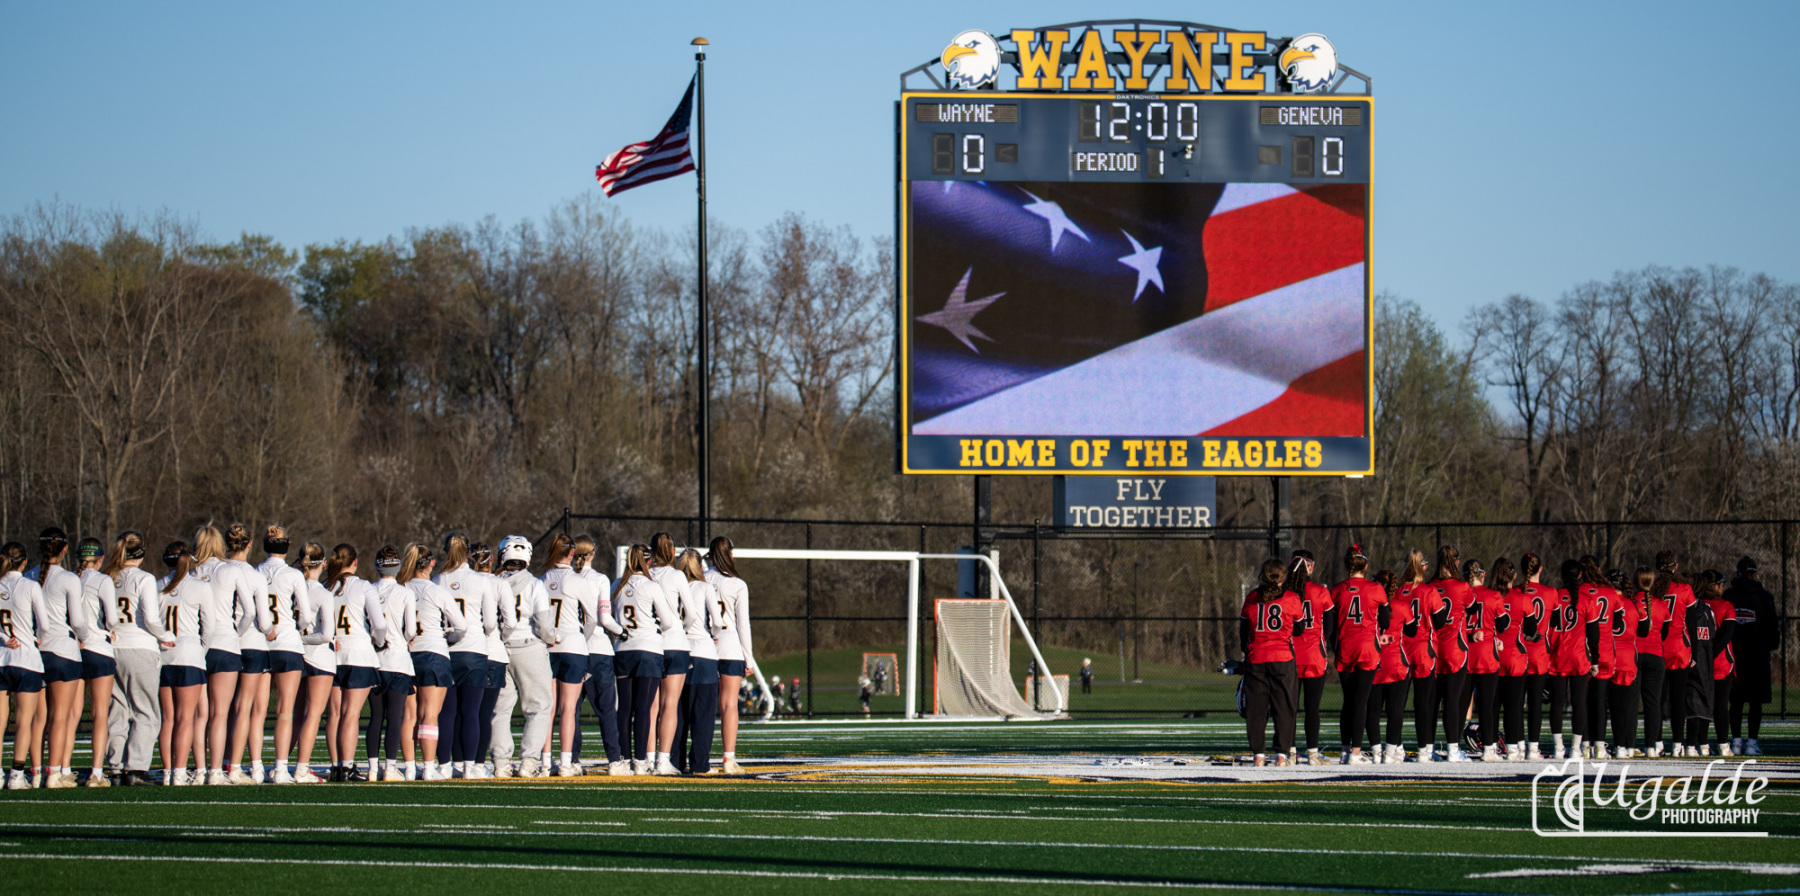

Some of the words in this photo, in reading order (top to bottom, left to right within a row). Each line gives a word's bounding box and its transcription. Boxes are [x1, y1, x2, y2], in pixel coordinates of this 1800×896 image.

[1010, 28, 1267, 92] WAYNE
[939, 103, 995, 122] WAYNE
[1095, 102, 1198, 140] 12:00
[1278, 106, 1343, 125] GENEVA
[963, 134, 984, 172] 0
[1077, 152, 1137, 171] PERIOD
[1322, 137, 1343, 175] 0
[959, 439, 1055, 468] HOME
[1070, 439, 1110, 468] OF
[1123, 439, 1188, 468] THE
[1202, 439, 1323, 468] EAGLES
[1116, 479, 1166, 501] FLY
[1069, 506, 1211, 528] TOGETHER
[118, 597, 133, 623] 3
[333, 604, 351, 635] 4
[550, 598, 562, 628] 7
[623, 605, 638, 629] 3
[1256, 603, 1282, 631] 18
[1347, 595, 1363, 624] 4
[1554, 604, 1578, 631] 19
[1596, 596, 1608, 623] 2
[1664, 594, 1677, 620] 7
[166, 605, 178, 637] 11
